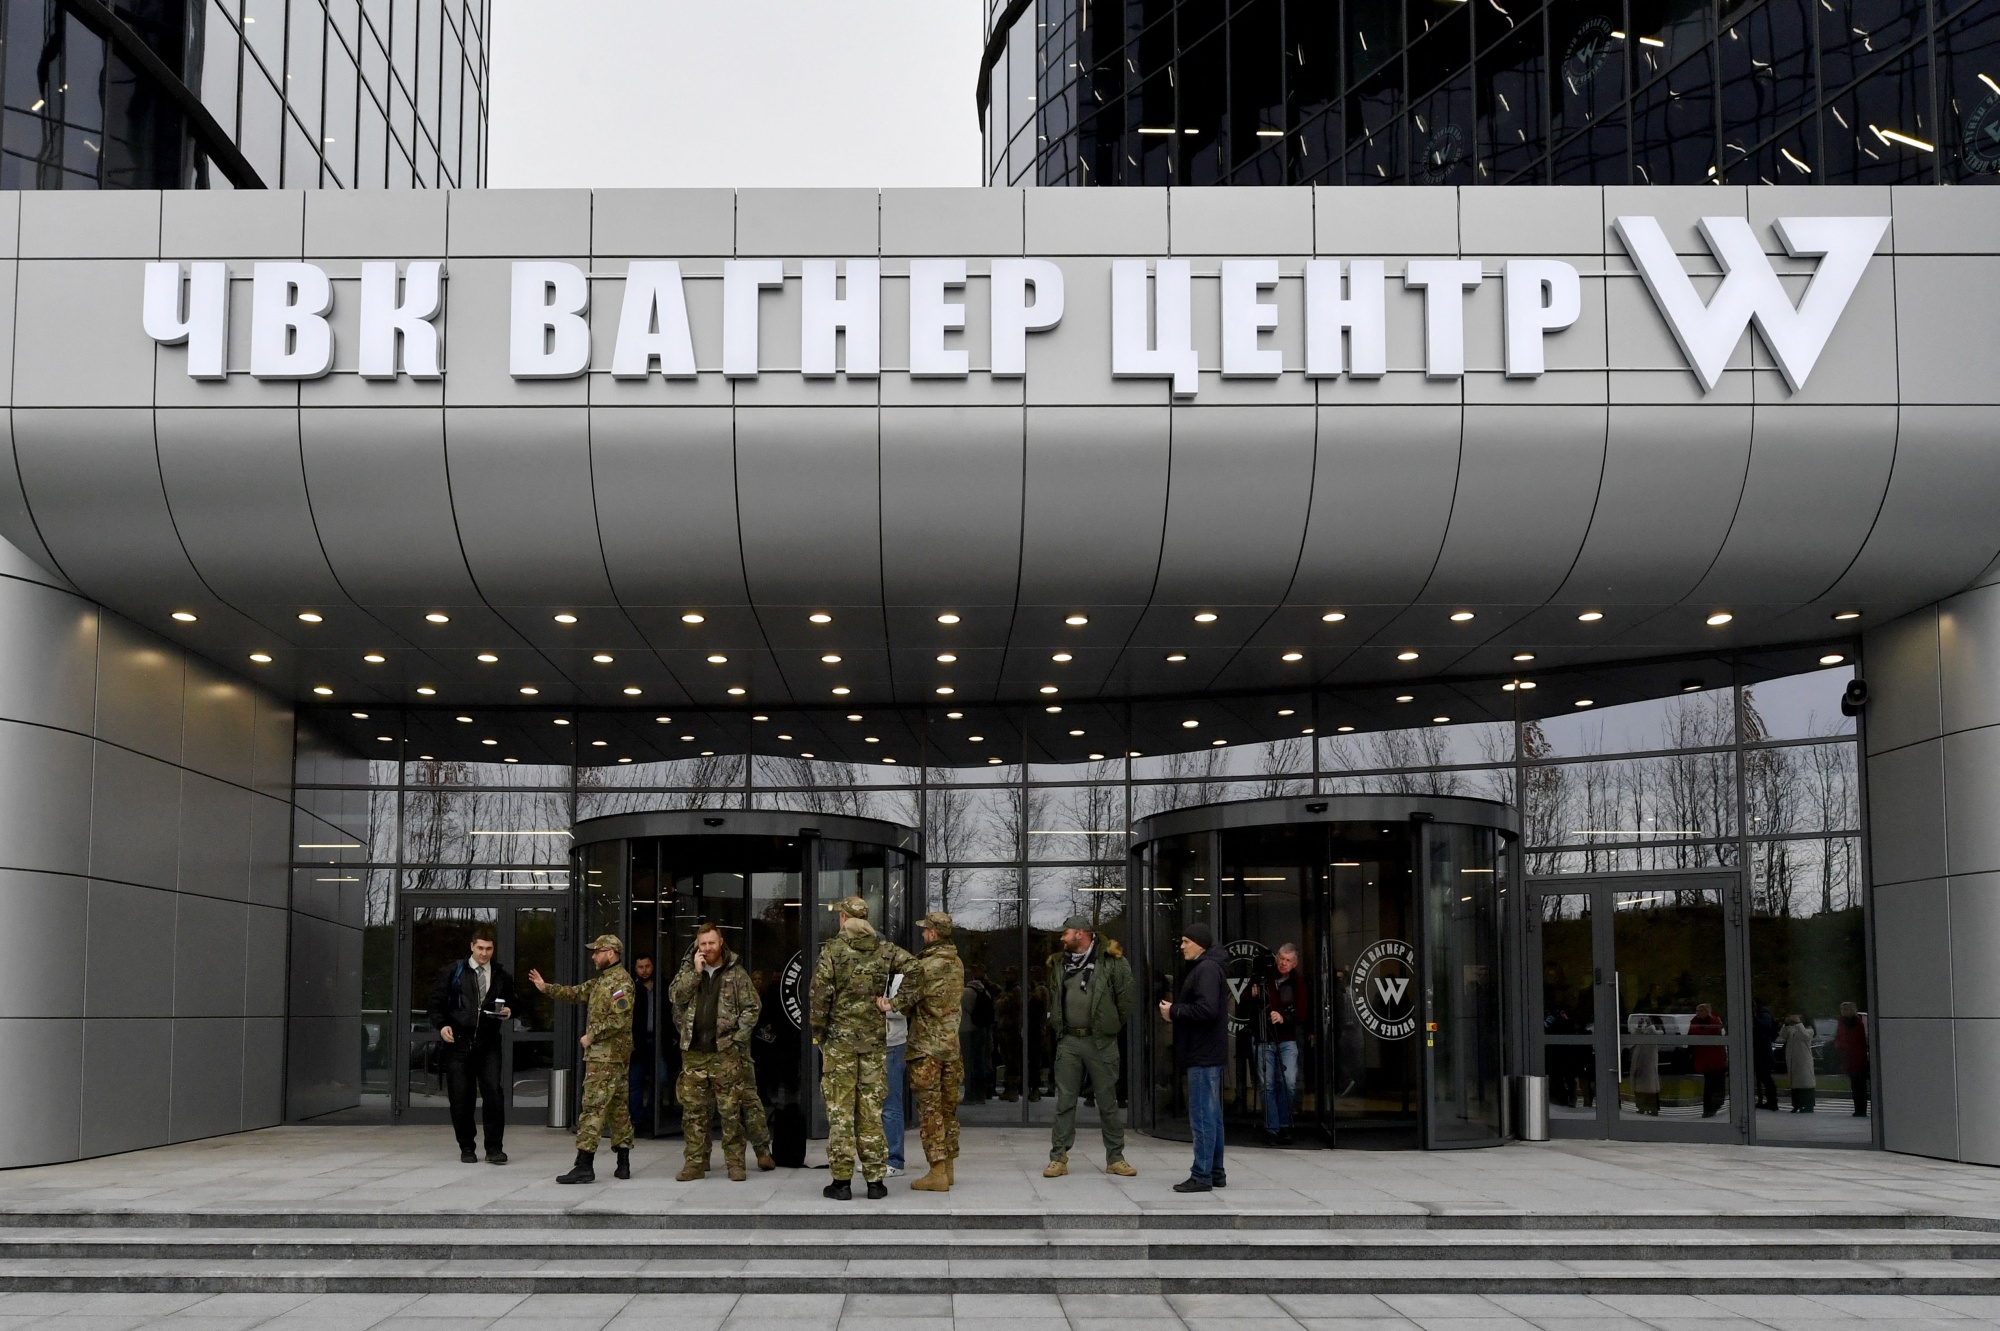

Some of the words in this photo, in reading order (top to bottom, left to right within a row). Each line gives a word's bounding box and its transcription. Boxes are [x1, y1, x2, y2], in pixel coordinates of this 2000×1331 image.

[142, 260, 445, 379] ЧВК
[509, 259, 1065, 379] ВАГНЕР
[1111, 258, 1582, 398] ЦЕНТР
[1615, 215, 1891, 394] W
[1355, 959, 1370, 984] ЧВК
[1368, 943, 1405, 962] ВАГНЕР
[1374, 977, 1410, 1006] W
